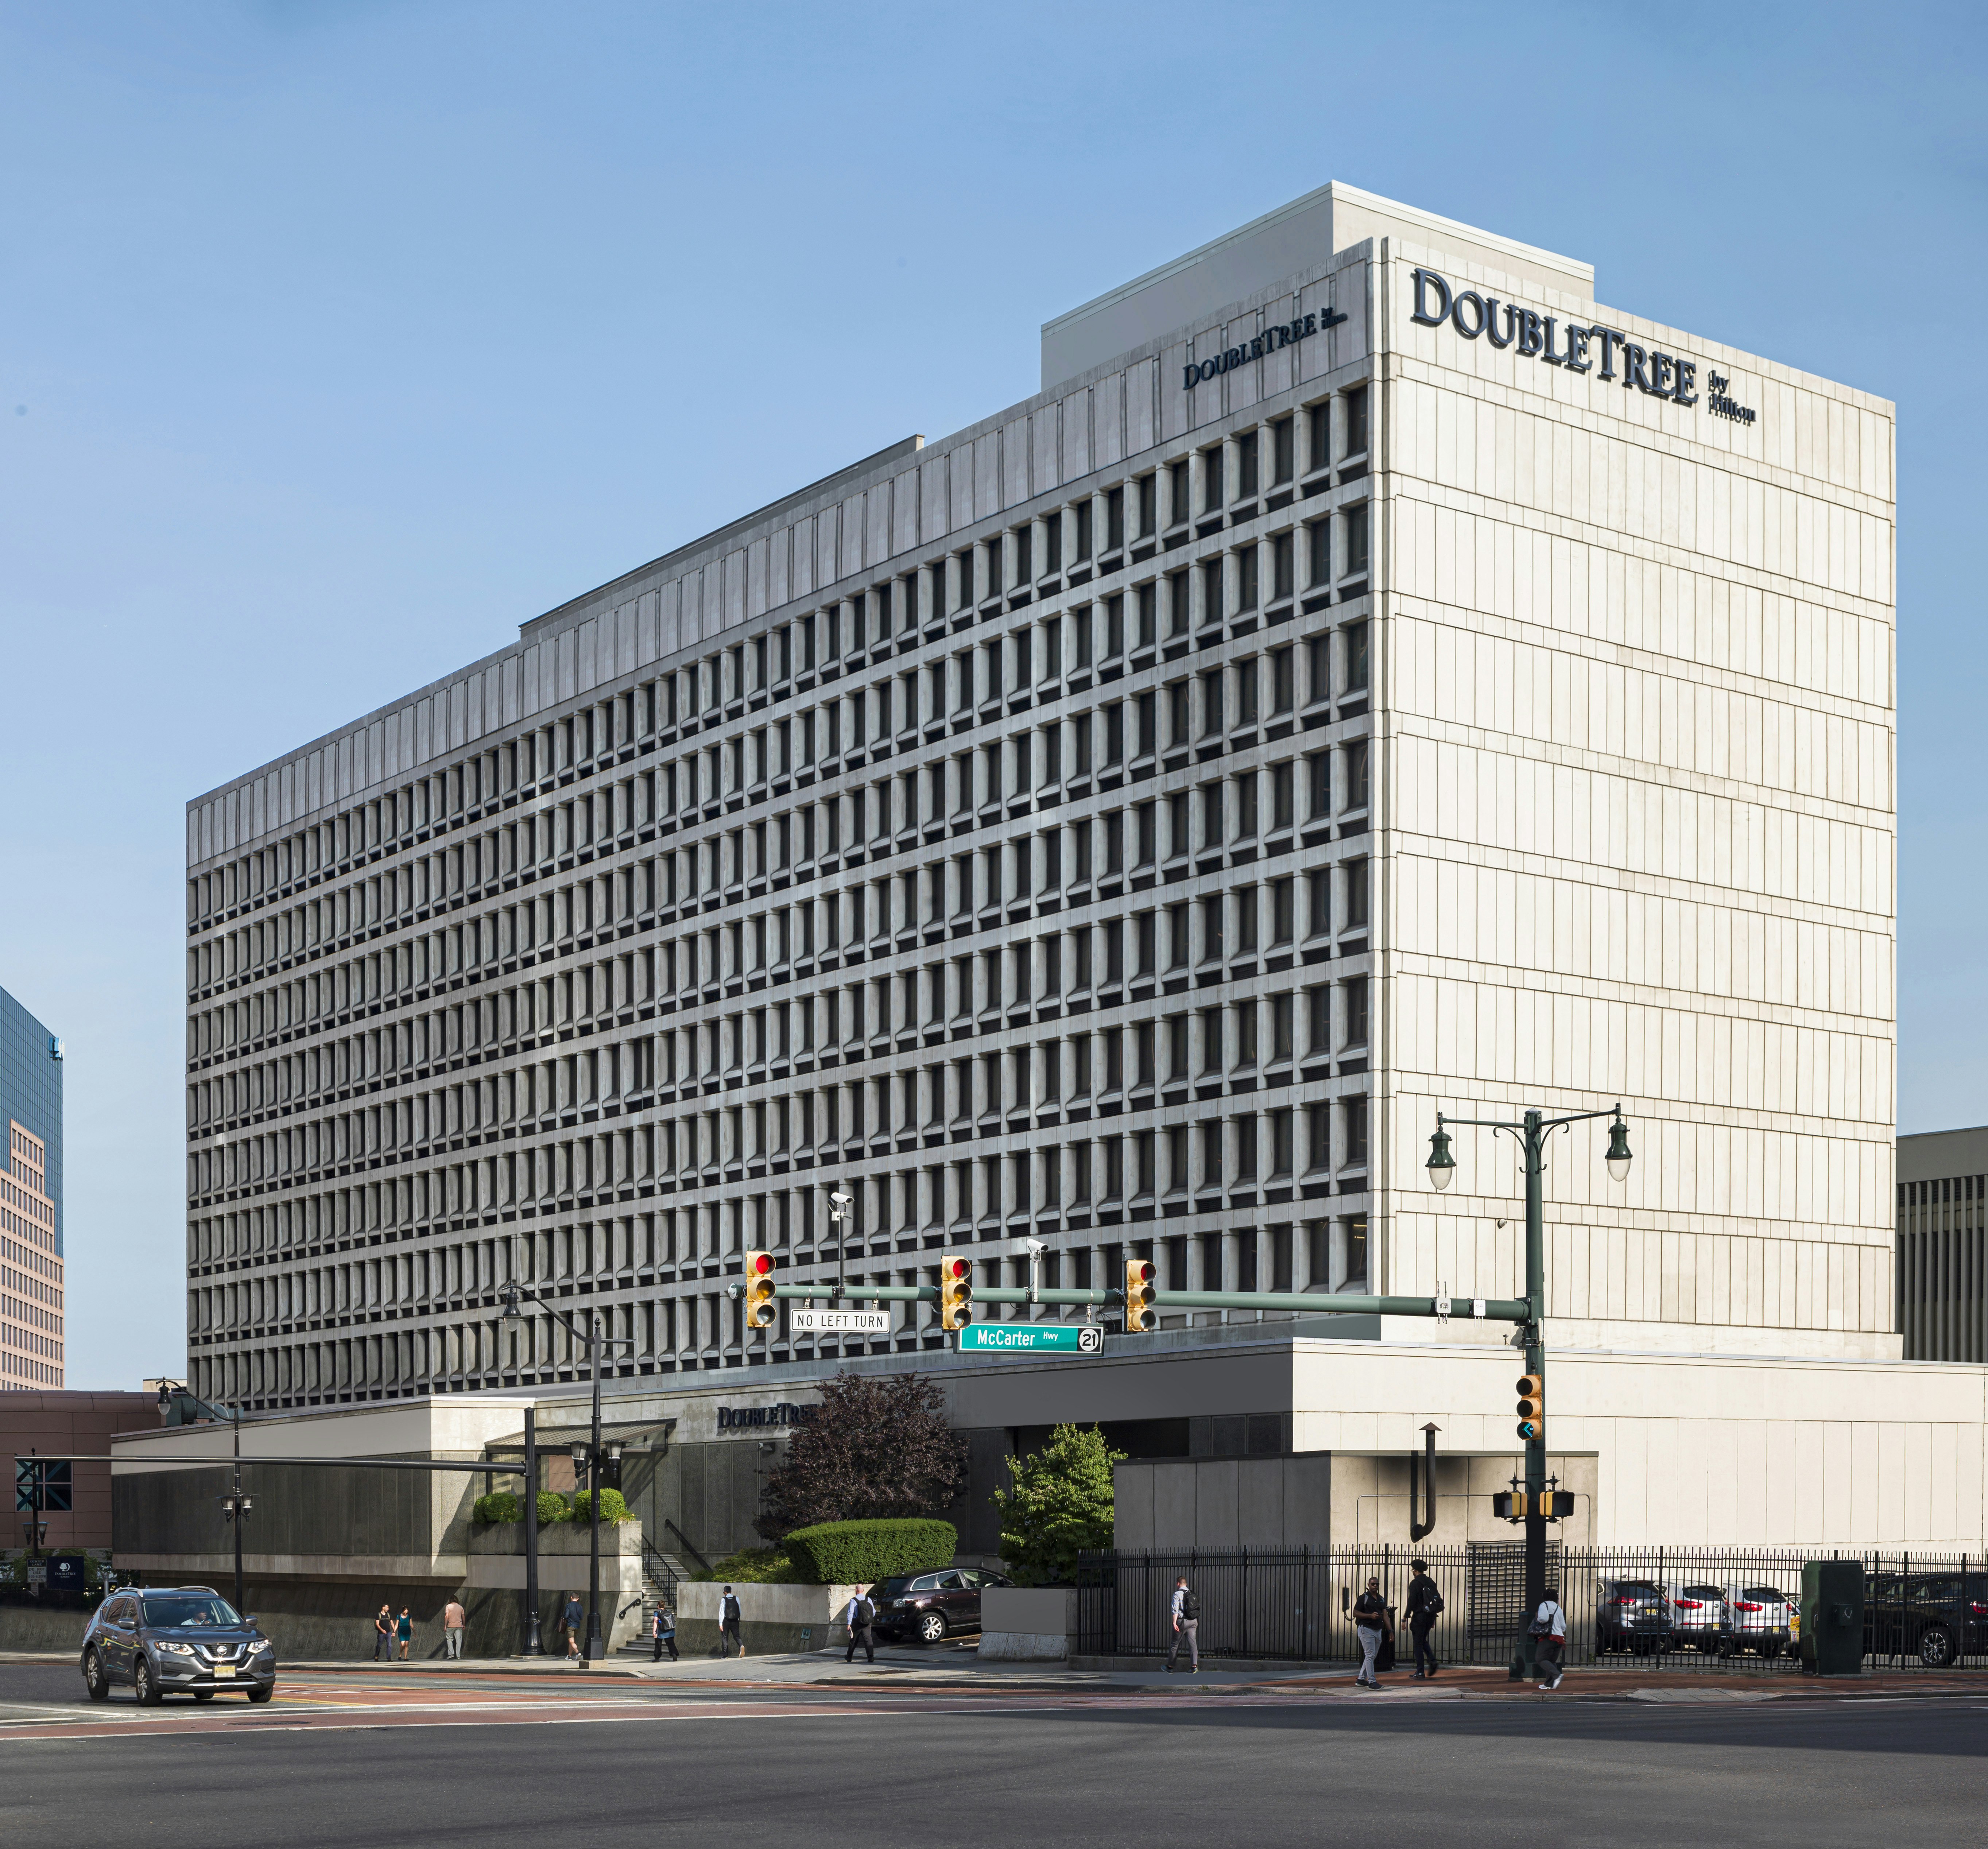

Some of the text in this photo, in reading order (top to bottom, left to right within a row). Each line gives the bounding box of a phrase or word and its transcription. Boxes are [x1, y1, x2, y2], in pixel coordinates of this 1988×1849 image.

[1710, 370, 1729, 394] by
[1710, 393, 1756, 422] Hilton
[798, 1315, 883, 1327] NO LEFT TURN
[977, 1329, 1096, 1346] McCarter Hwy 21
